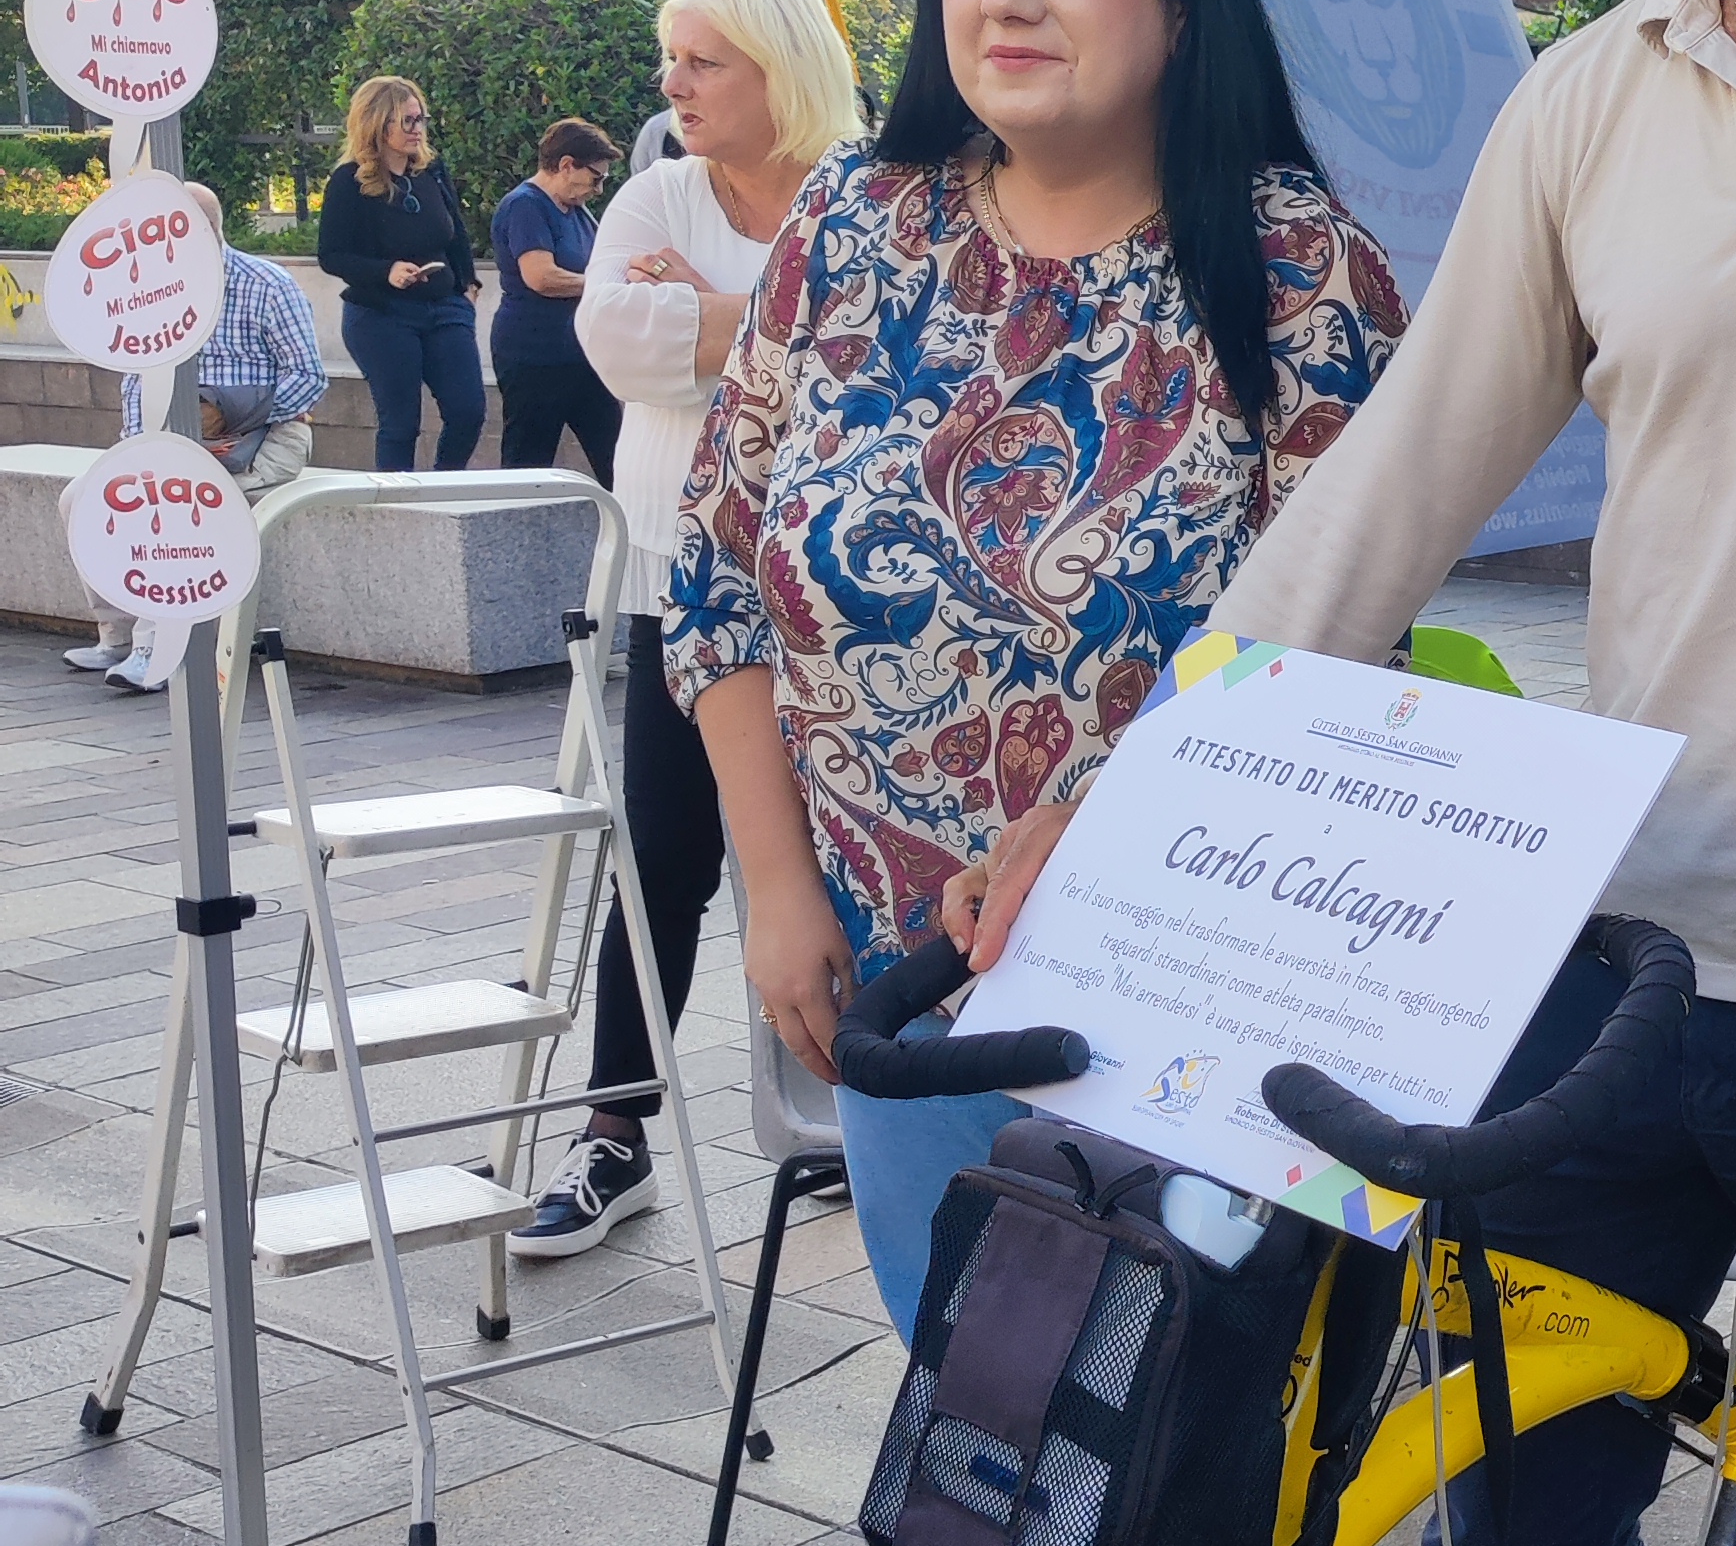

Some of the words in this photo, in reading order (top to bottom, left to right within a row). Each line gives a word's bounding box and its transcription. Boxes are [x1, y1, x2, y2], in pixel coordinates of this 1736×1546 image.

[91, 34, 108, 53] Mi
[110, 35, 172, 55] chiamavo
[77, 58, 187, 103] Antonia
[80, 209, 190, 269] Ciao
[106, 296, 124, 319] Mi
[126, 278, 185, 312] chiamavo
[107, 304, 198, 356] Jessica
[103, 470, 223, 513] Ciao
[130, 543, 148, 562] Mi
[151, 543, 215, 561] chiamavo
[123, 568, 229, 607] Gessica
[1386, 735, 1408, 750] SAN
[1409, 741, 1463, 764] GIOVANNI
[1172, 736, 1295, 786] ATTESTATO
[1296, 768, 1330, 795] DI
[1329, 775, 1418, 819] MERITO
[1421, 800, 1548, 853] SPORTIVO
[1323, 823, 1333, 835] a
[1165, 825, 1274, 890] Carlo
[1271, 856, 1455, 955] Calcagni
[1059, 872, 1081, 901] Per
[1081, 878, 1100, 904] il
[1091, 893, 1114, 910] suo
[1114, 900, 1165, 930] coraggio
[1165, 907, 1194, 932] nel
[1185, 916, 1260, 956] trasformare
[1259, 932, 1277, 961] le
[1274, 951, 1337, 981] avversità
[1335, 963, 1352, 985] in
[1352, 961, 1390, 1002] forza,
[1394, 988, 1491, 1030] raggiungendo
[1099, 932, 1160, 964] traguardi
[1154, 952, 1231, 987] straordinari
[1227, 977, 1263, 999] come
[1263, 979, 1303, 1013] atleta
[1298, 997, 1385, 1042] paralimpico.
[1013, 934, 1032, 961] Il
[1023, 950, 1046, 968] suo
[1045, 956, 1106, 991] messaggio
[1205, 1007, 1217, 1026] è
[1215, 1013, 1241, 1035] una
[1236, 1020, 1289, 1050] grande
[1287, 1035, 1361, 1075] ispirazione
[1357, 1065, 1389, 1086] per
[1388, 1070, 1427, 1098] tutti
[1423, 1087, 1453, 1109] noi.
[1090, 1050, 1126, 1070] Giovanni
[1234, 1104, 1270, 1125] Roberto
[1536, 1310, 1591, 1339] .com
